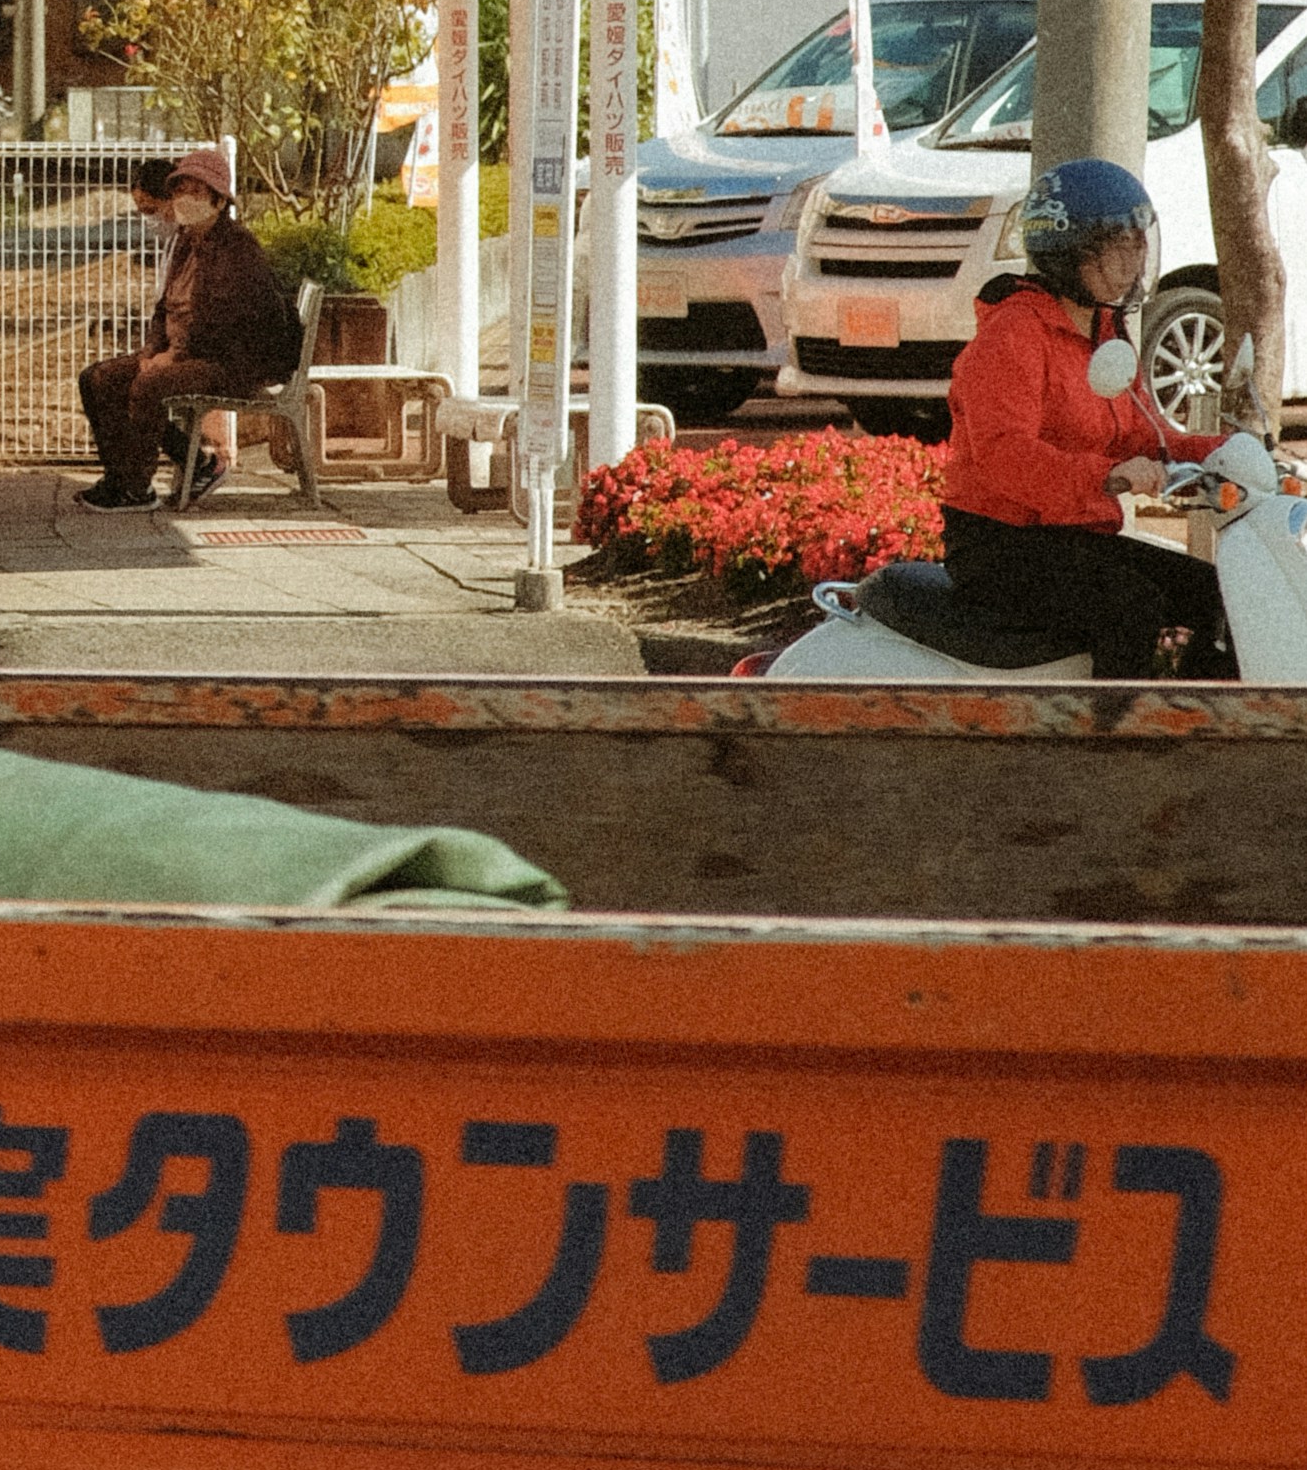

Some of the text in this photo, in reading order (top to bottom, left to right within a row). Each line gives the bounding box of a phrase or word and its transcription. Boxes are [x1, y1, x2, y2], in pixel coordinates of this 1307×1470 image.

[451, 9, 469, 160] 愛媛ダイハツ販売
[605, 2, 626, 175] 愛媛ダイハツ販売
